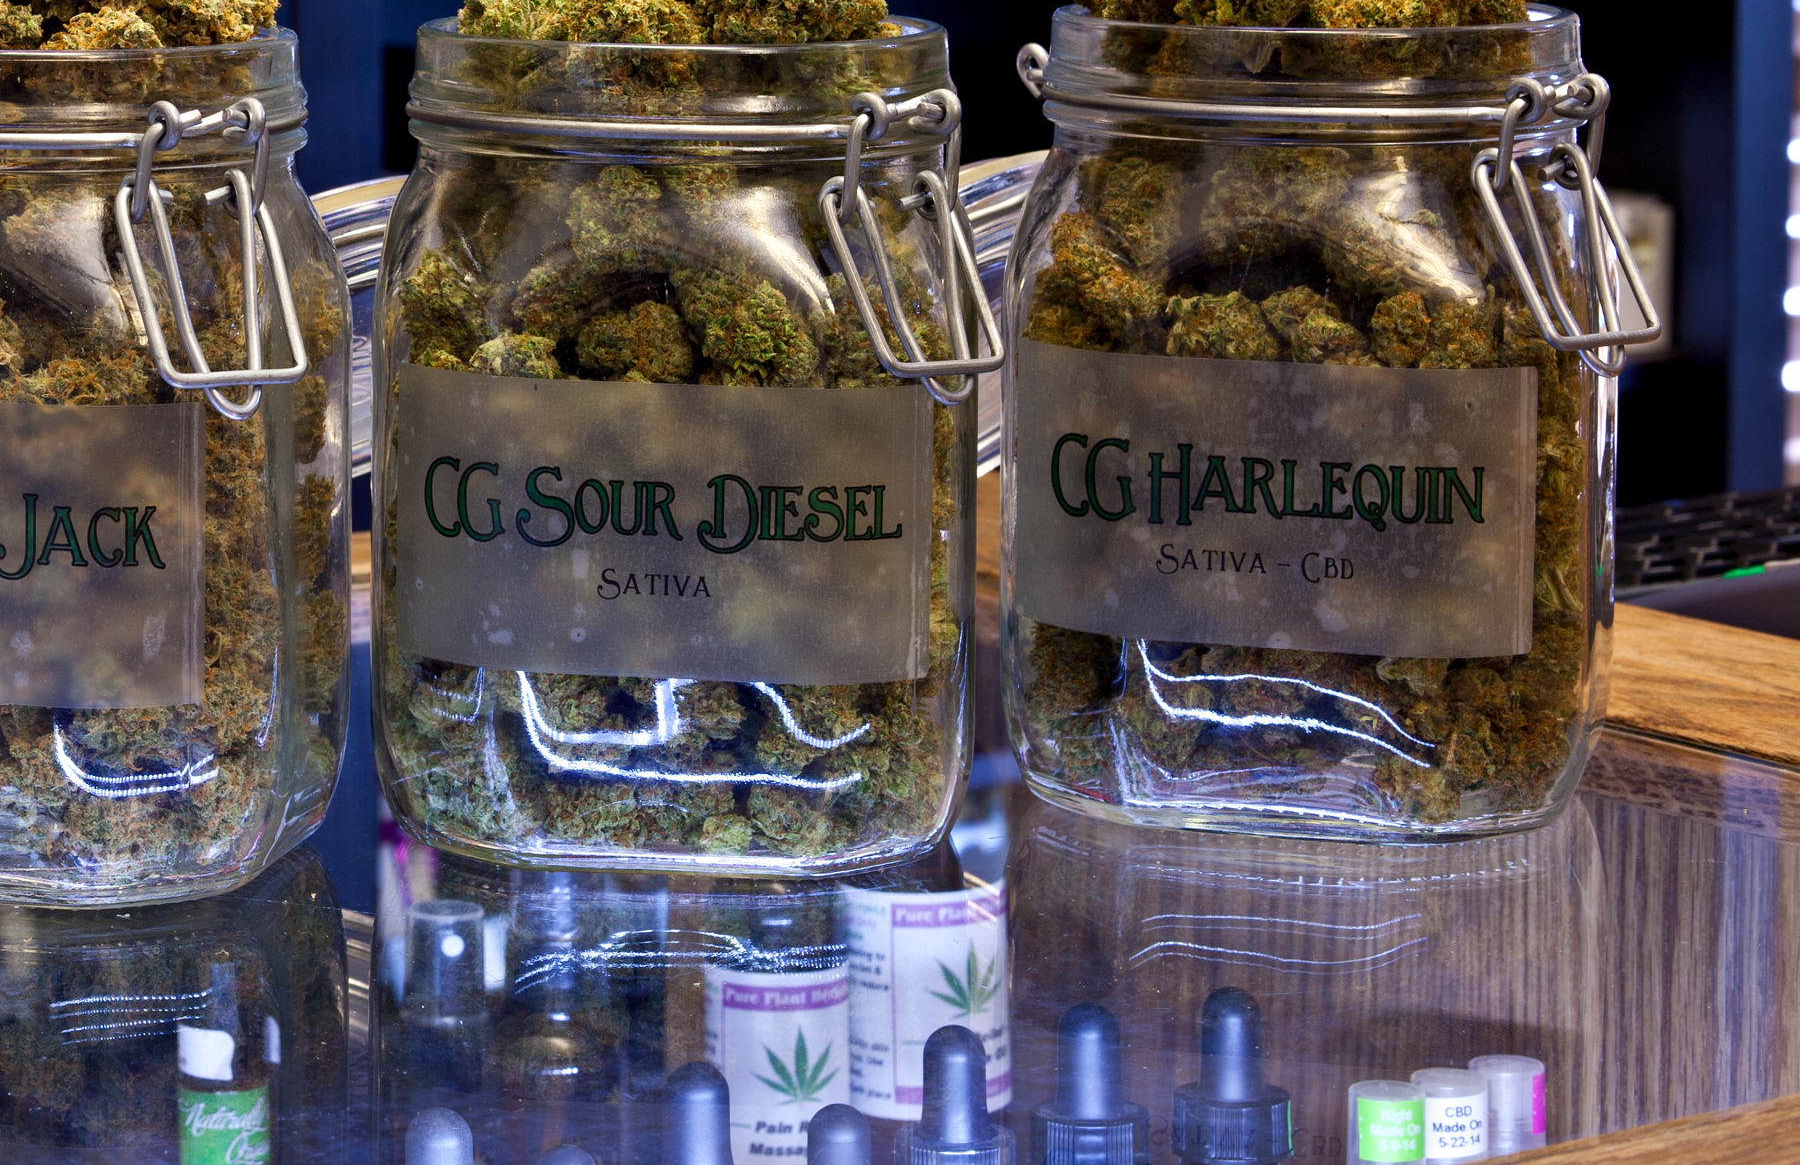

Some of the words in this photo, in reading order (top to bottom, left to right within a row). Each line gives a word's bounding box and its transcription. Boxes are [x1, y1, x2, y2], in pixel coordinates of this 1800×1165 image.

[1050, 433, 1136, 521] CG
[1147, 443, 1485, 531] HARLEQUIN
[424, 456, 504, 543] CG
[515, 466, 684, 548] SOUR
[696, 474, 902, 555] DIESEL
[1155, 543, 1267, 575] SATIVA
[1301, 552, 1355, 584] CBD
[596, 568, 712, 600] SATIVA
[896, 907, 933, 922] Pure
[724, 986, 760, 1005] Pure
[1381, 1110, 1413, 1125] Night
[1445, 1106, 1473, 1118] CBD
[755, 1121, 793, 1133] Pain
[1370, 1124, 1406, 1135] Made
[1407, 1123, 1422, 1135] On
[1432, 1122, 1466, 1133] Made
[1469, 1119, 1483, 1130] On
[1438, 1134, 1481, 1148] 5-22-14
